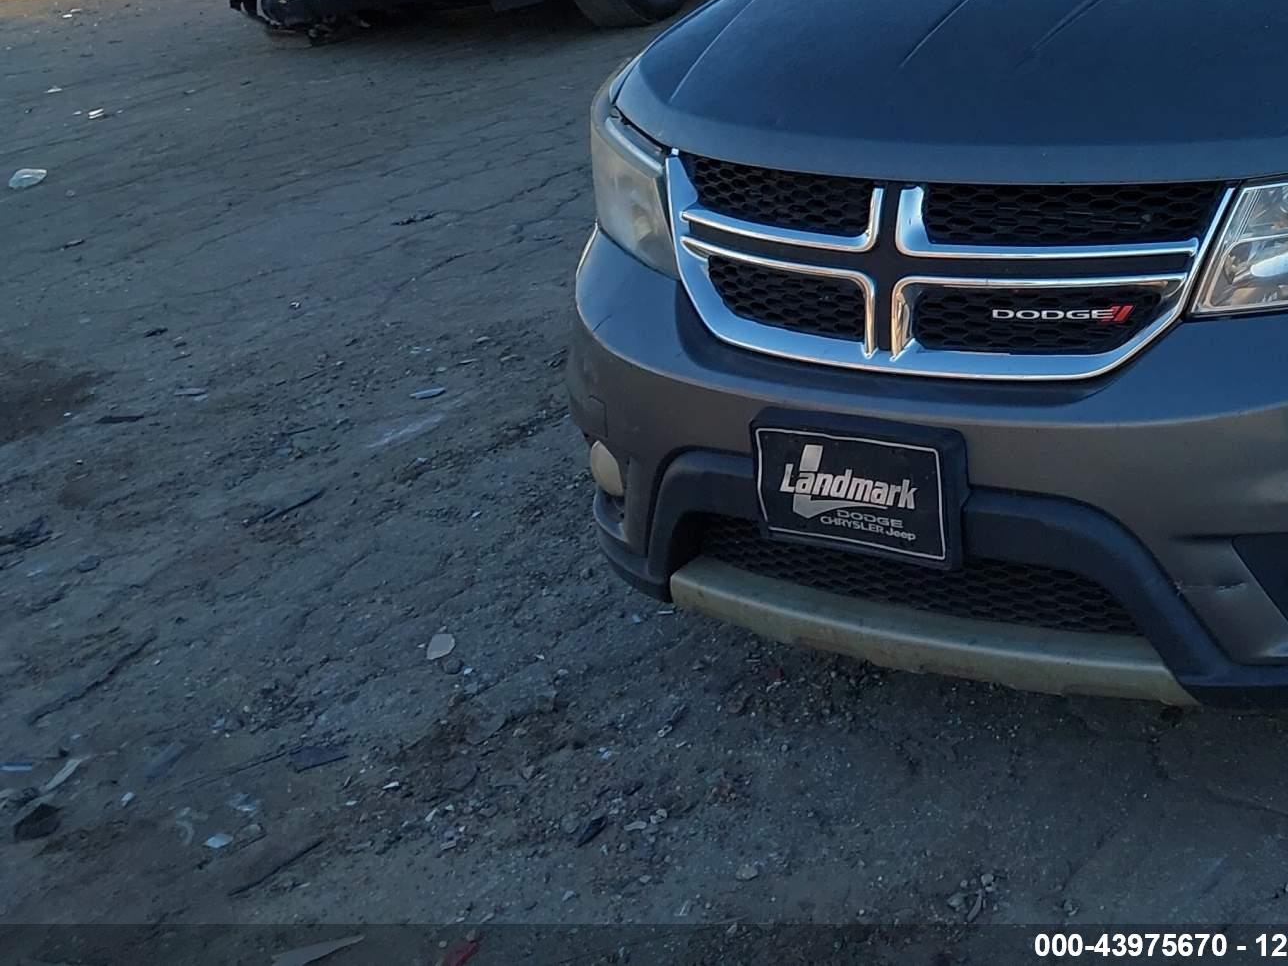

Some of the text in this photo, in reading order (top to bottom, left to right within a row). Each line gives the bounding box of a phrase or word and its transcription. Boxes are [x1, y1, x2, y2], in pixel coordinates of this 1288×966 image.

[991, 309, 1115, 320] DODGE
[779, 463, 919, 510] Landmark
[820, 515, 917, 542] CHRYSLER Jeep
[837, 509, 904, 529] DODGE
